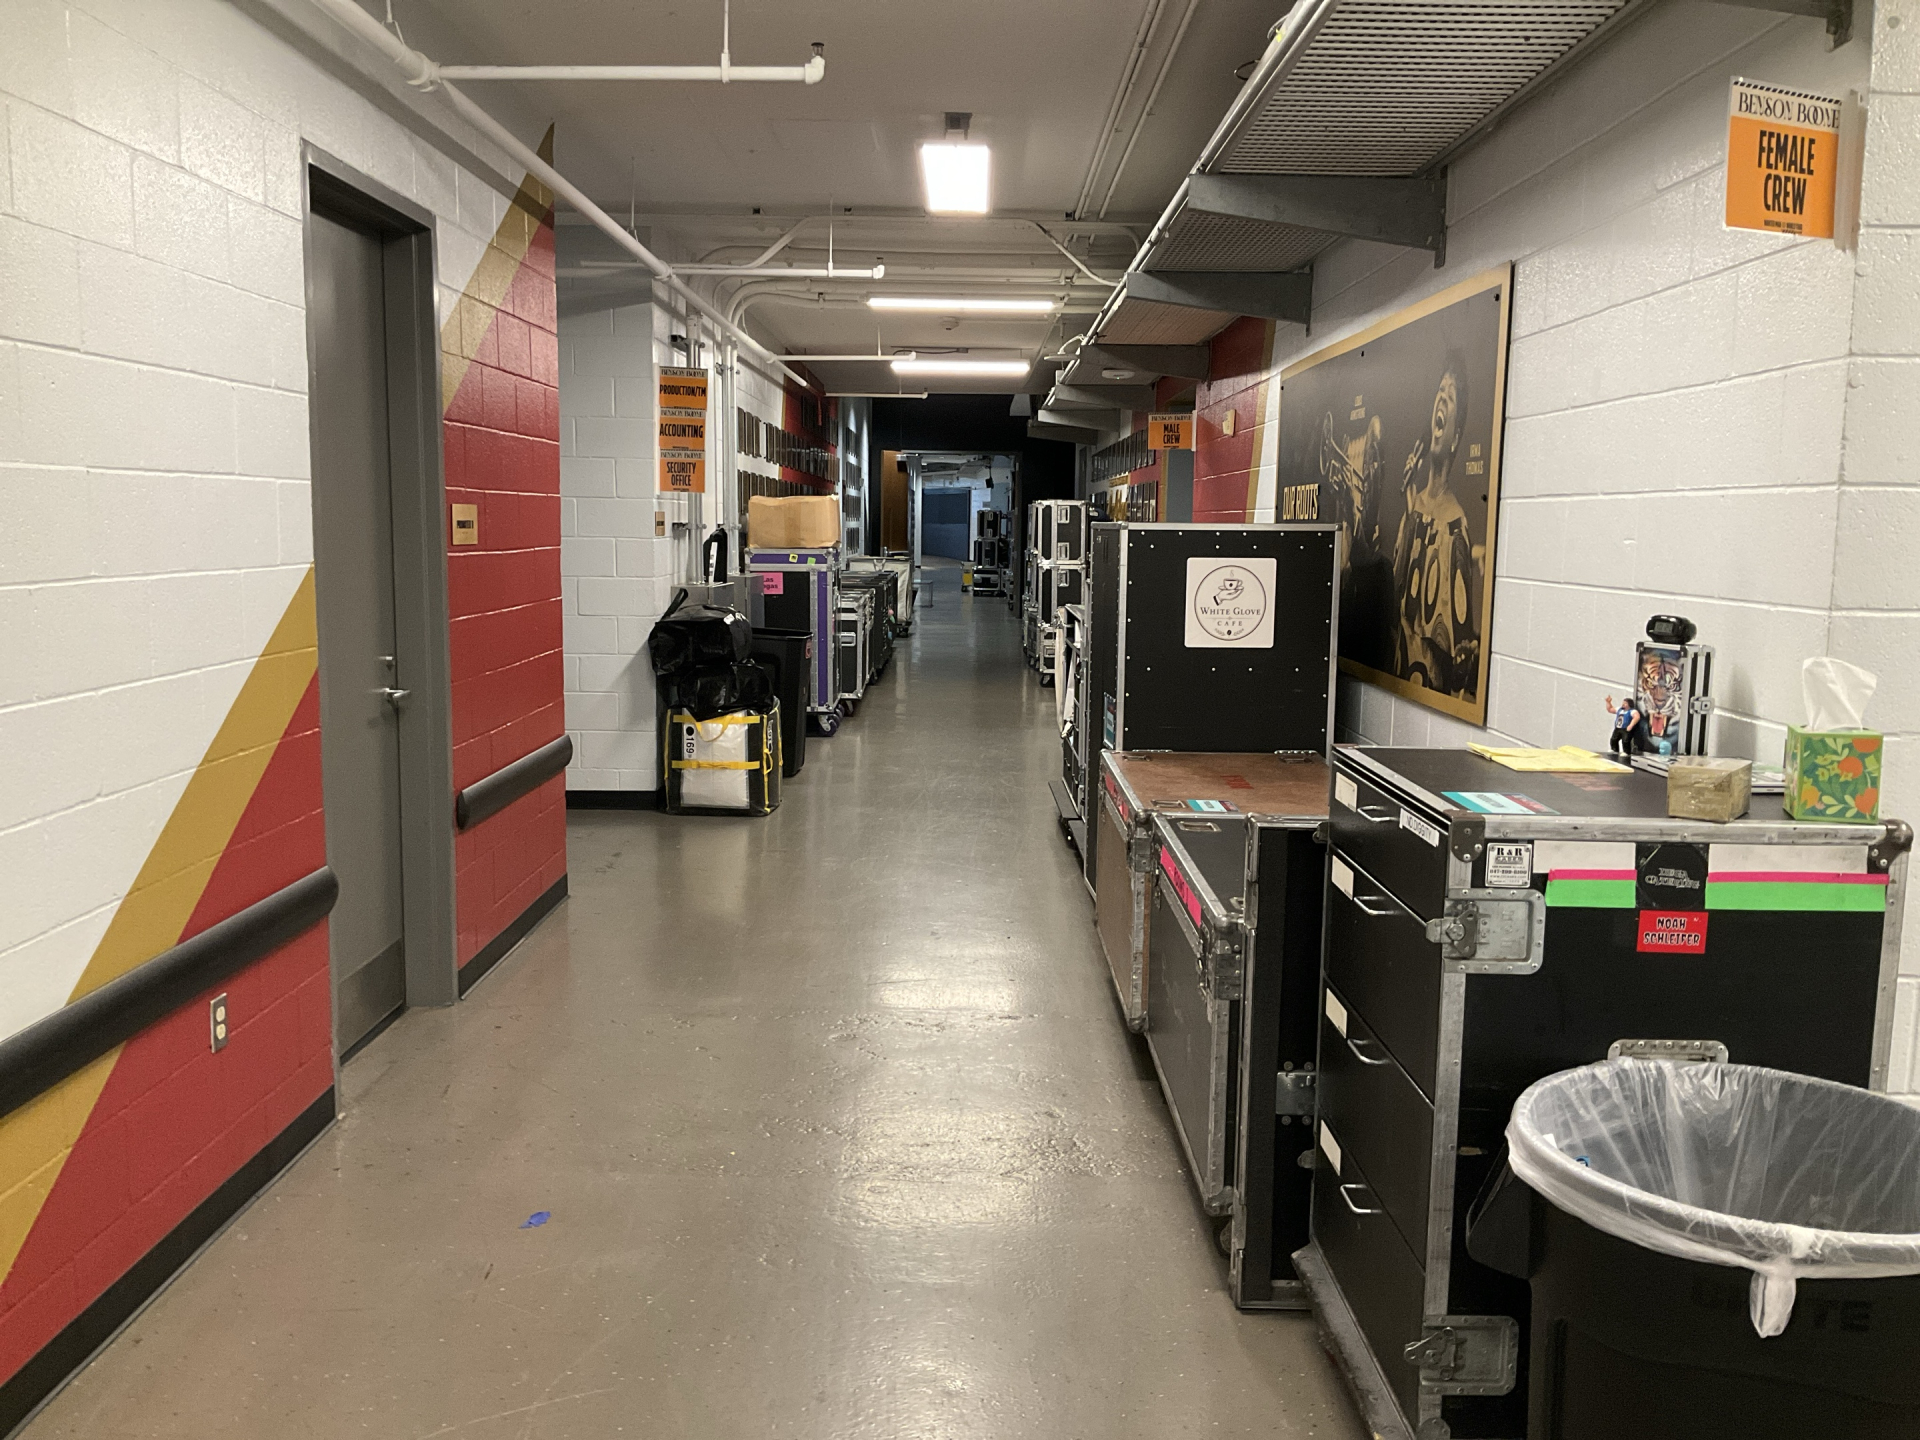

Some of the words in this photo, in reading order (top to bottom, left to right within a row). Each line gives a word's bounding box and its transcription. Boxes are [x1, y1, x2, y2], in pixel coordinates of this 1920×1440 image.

[1738, 91, 1794, 121] BENSON
[1797, 102, 1840, 129] BOONE
[1758, 130, 1816, 176] FEMALE
[1763, 172, 1807, 215] CREW
[660, 385, 706, 397] PRODUCTION/TM
[660, 424, 703, 438] ACCOUNTING
[1163, 423, 1180, 433] MALE
[1163, 434, 1181, 444] CREW
[666, 461, 696, 474] SECURITY
[671, 474, 692, 486] OFFICE
[1283, 486, 1295, 520] OUR
[1296, 483, 1319, 520] ROOTS
[1200, 606, 1230, 616] WHITE
[1233, 607, 1261, 616] GLOVE
[685, 737, 695, 754] 169
[1497, 847, 1504, 856] R
[1515, 848, 1522, 856] R
[1656, 917, 1687, 930] NOAH
[1644, 932, 1700, 945] SCHLEIFER
